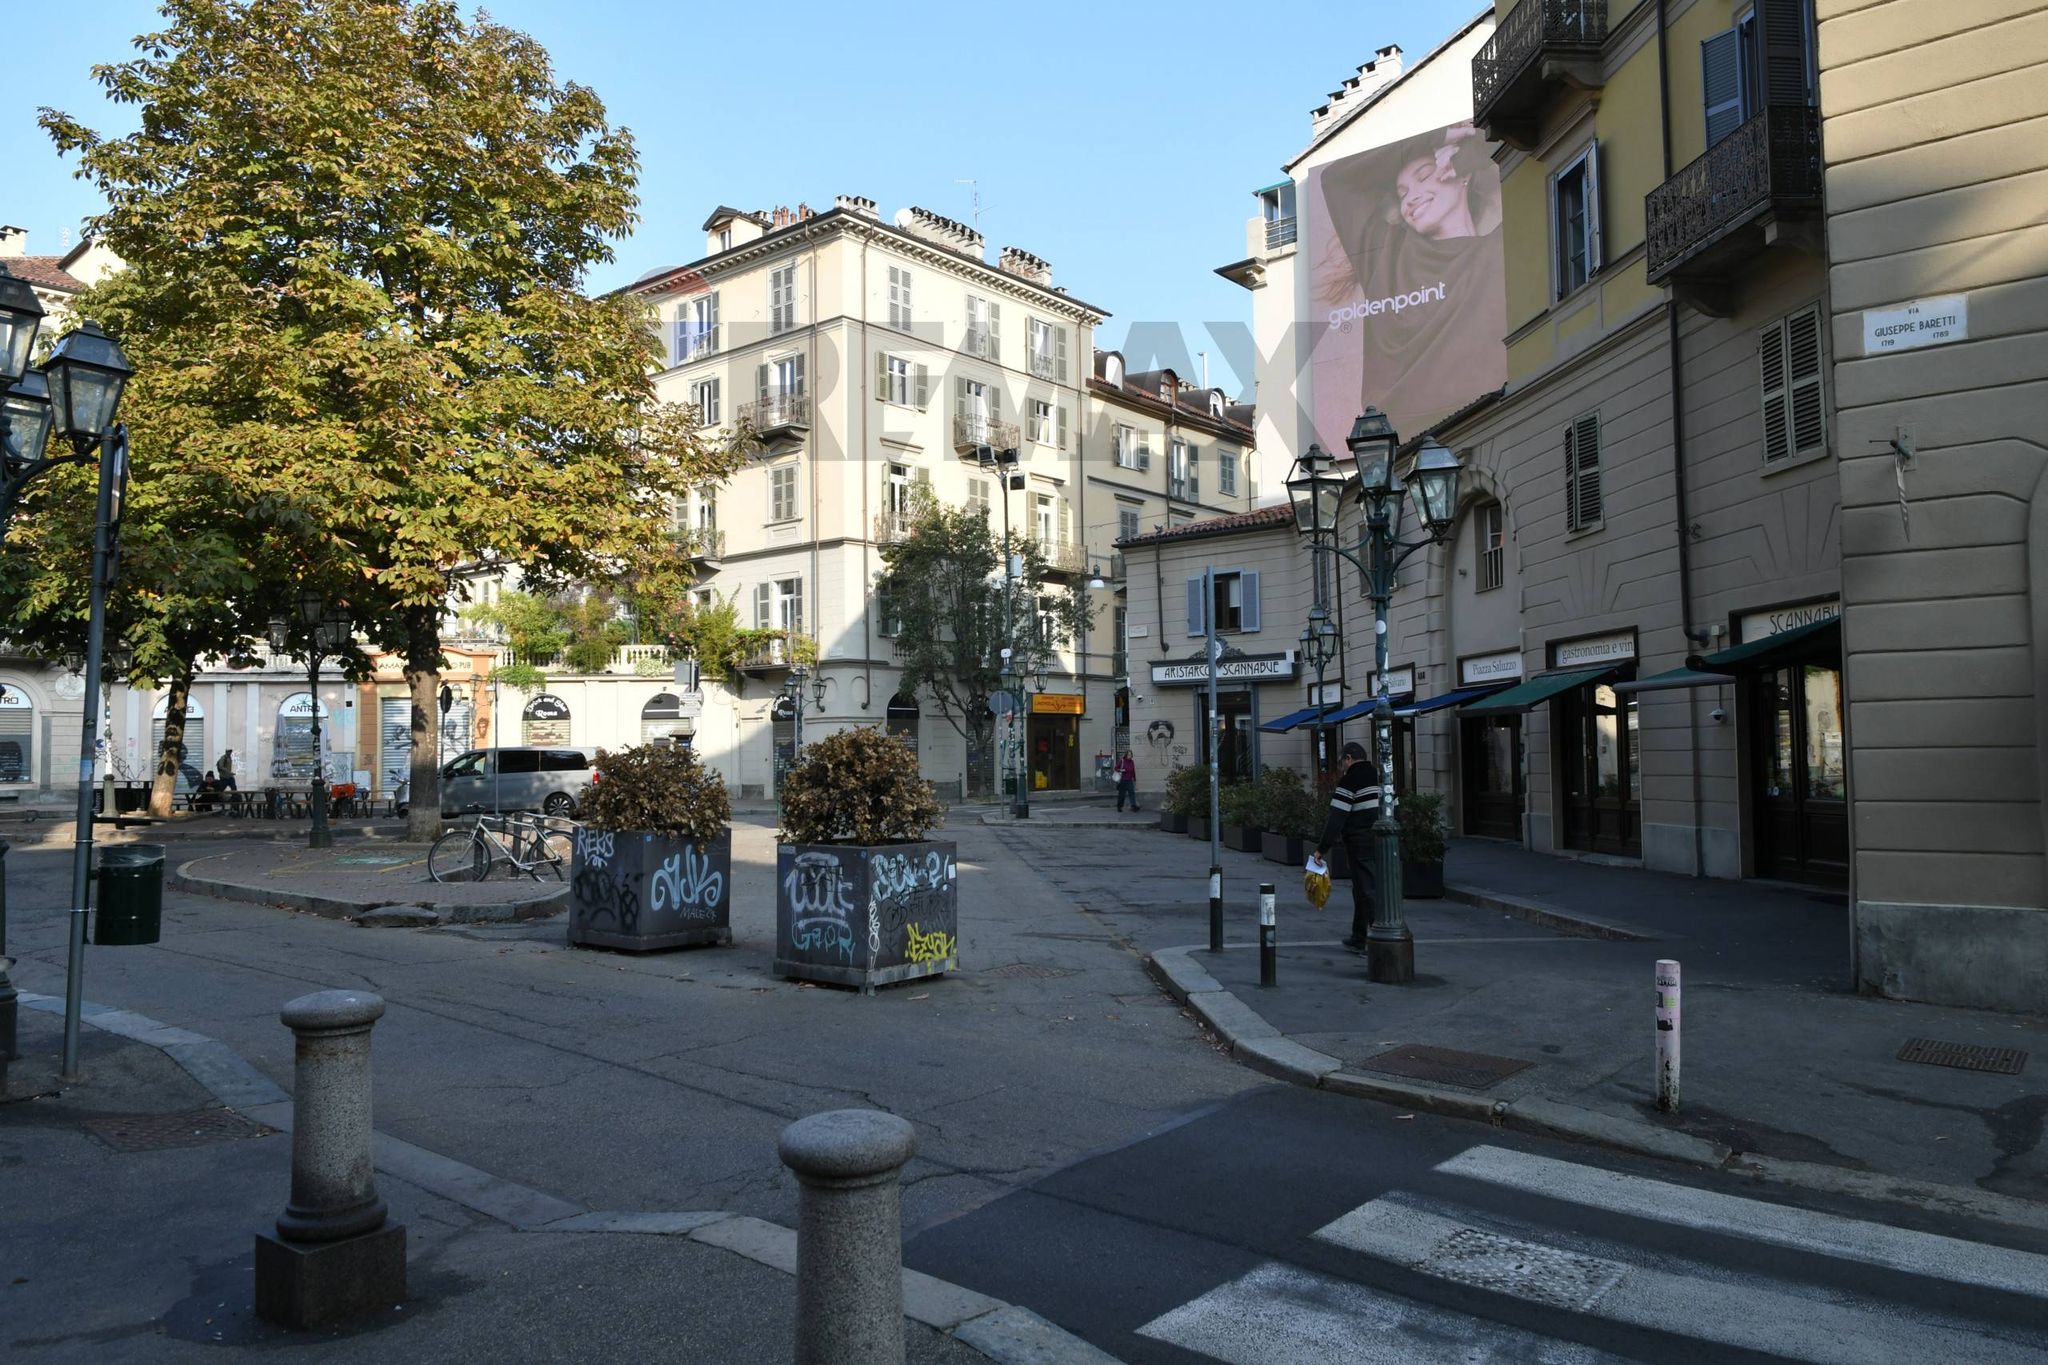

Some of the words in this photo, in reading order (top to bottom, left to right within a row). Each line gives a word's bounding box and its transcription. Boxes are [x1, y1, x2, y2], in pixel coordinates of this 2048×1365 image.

[1328, 281, 1446, 330] goldenpoint
[1908, 307, 1919, 315] VIA
[1874, 322, 1916, 338] GIUSEPPE
[1918, 315, 1956, 331] BARETTI
[1933, 330, 1949, 339] 1789
[1562, 641, 1610, 665] gastronomia
[1612, 643, 1617, 653] e
[1472, 664, 1492, 676] Piazza
[1492, 660, 1517, 673] Saluzzo
